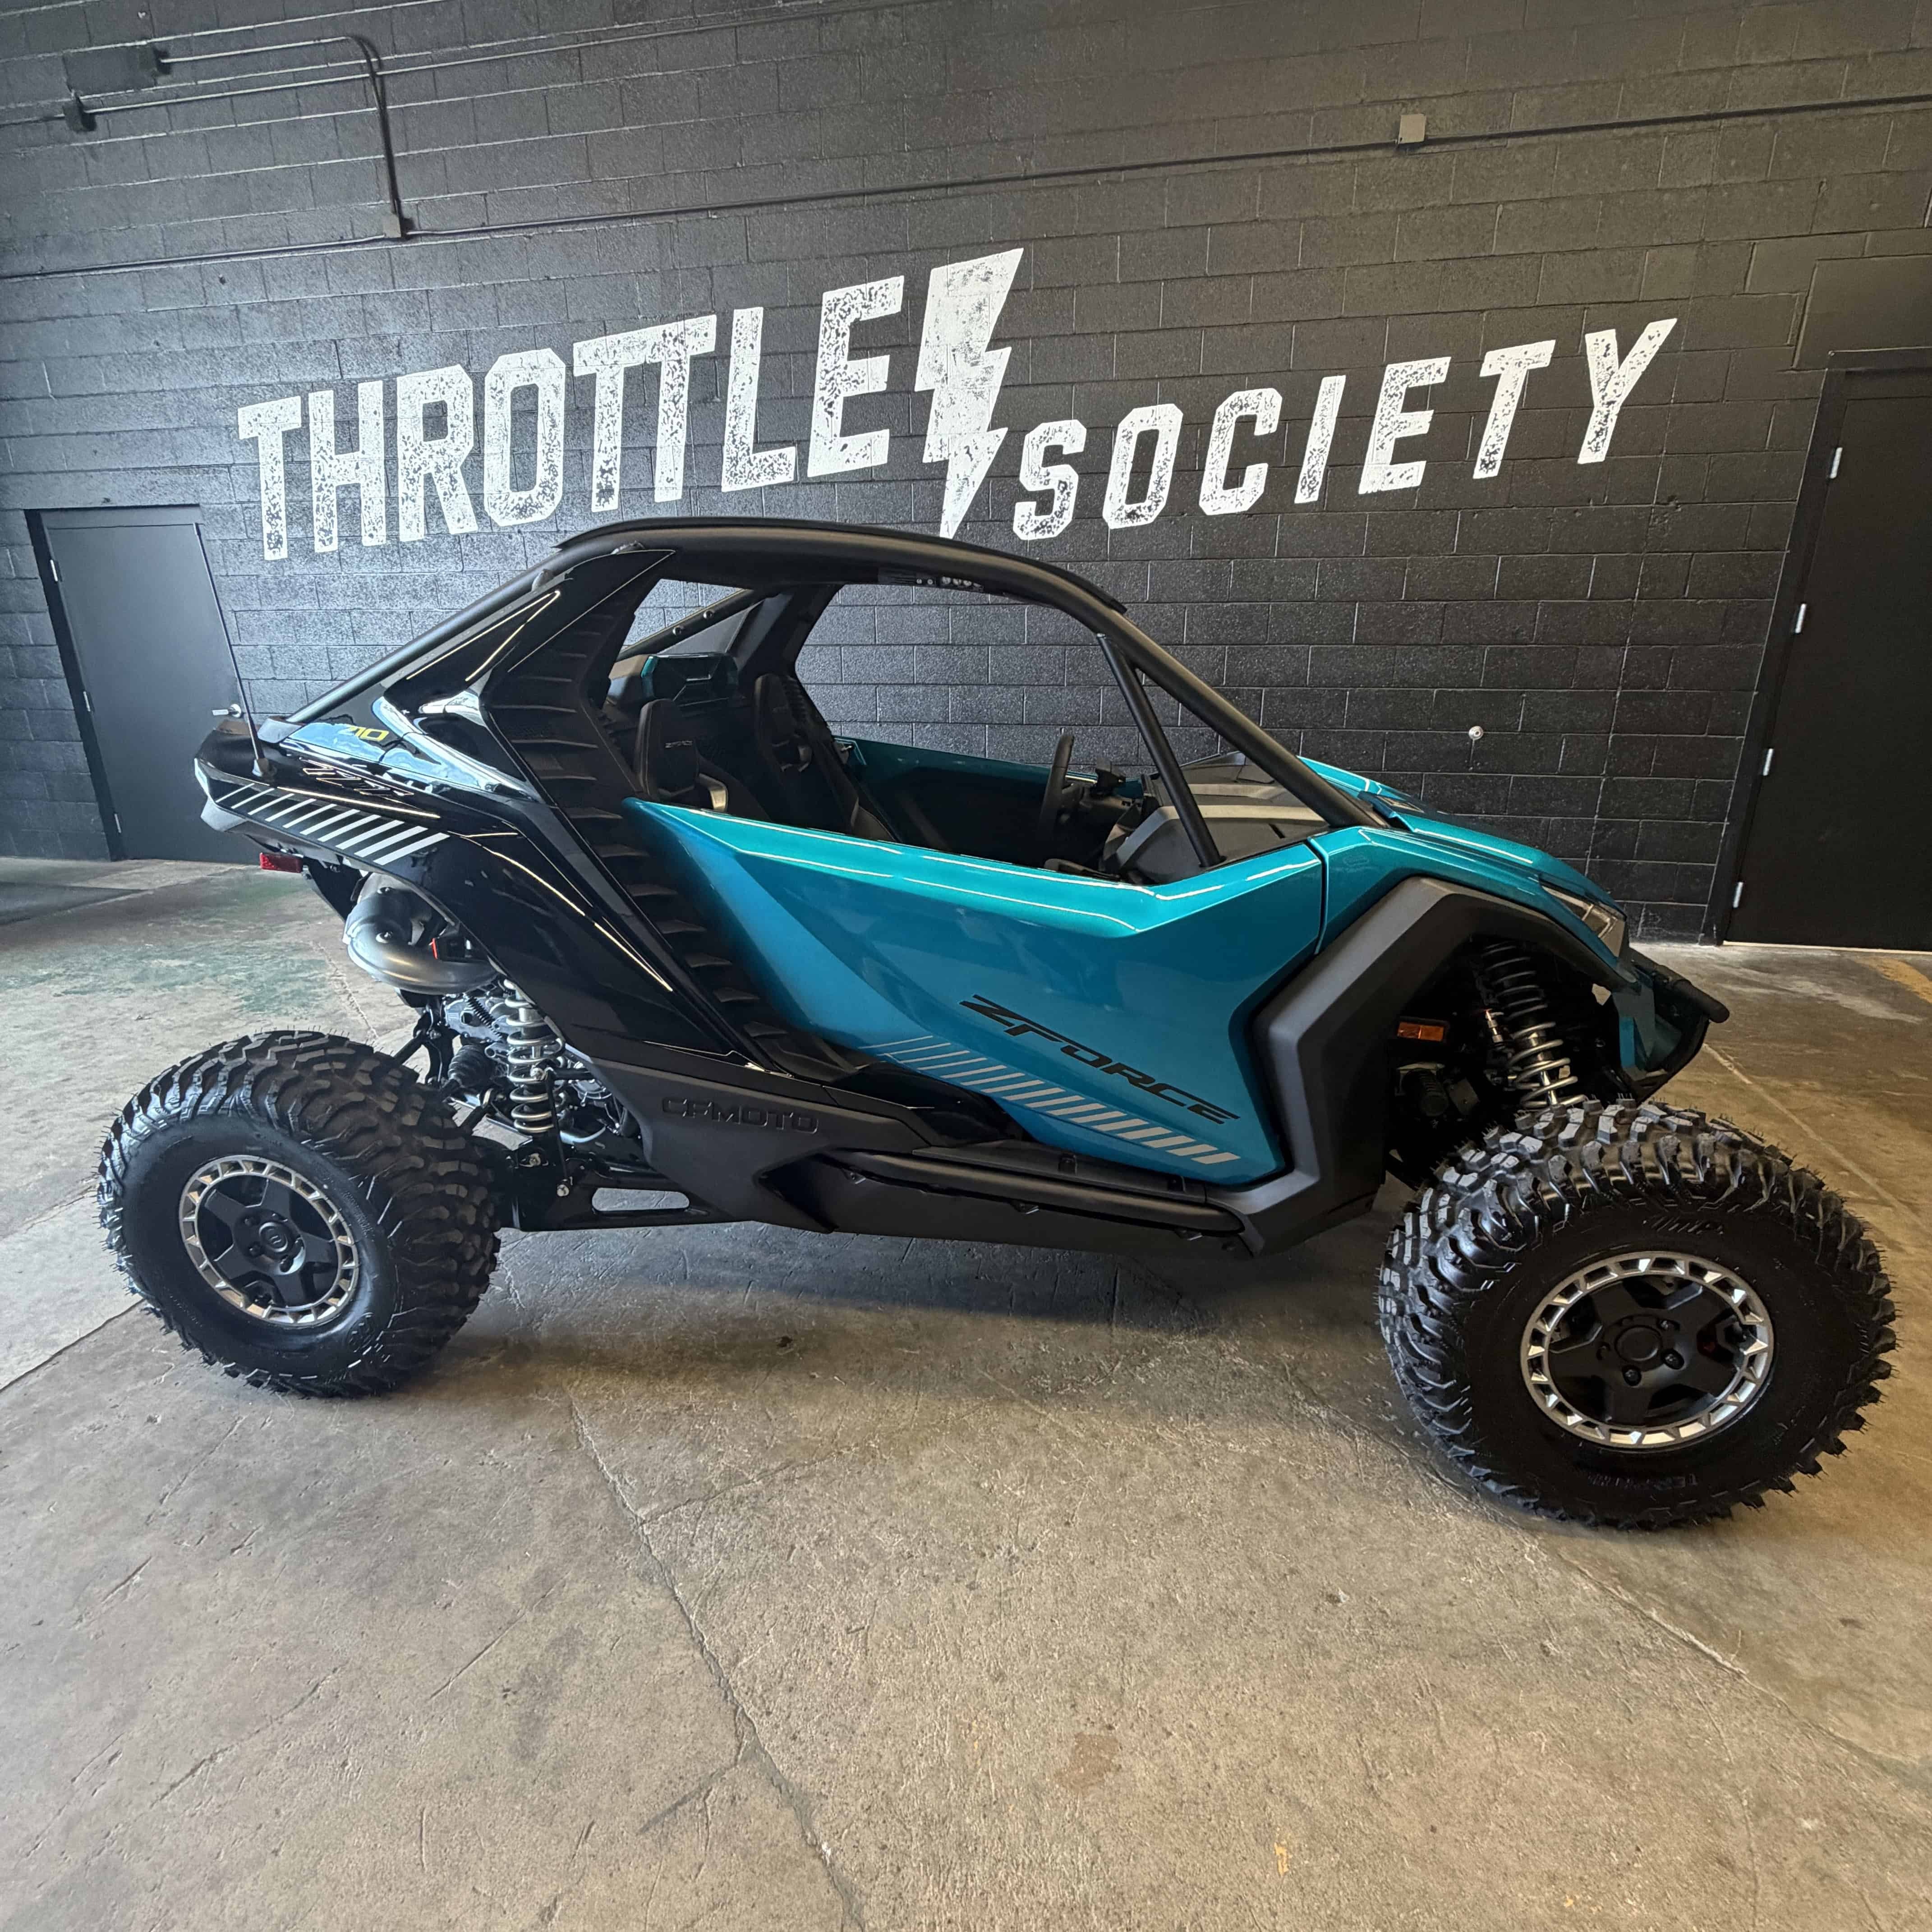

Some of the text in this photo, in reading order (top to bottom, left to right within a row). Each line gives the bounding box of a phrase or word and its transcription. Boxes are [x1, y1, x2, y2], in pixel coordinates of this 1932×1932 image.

[238, 275, 1678, 560] THROTTLE SOCIETY
[662, 1098, 819, 1134] CFMOTO
[959, 994, 1241, 1125] ZFORCE
